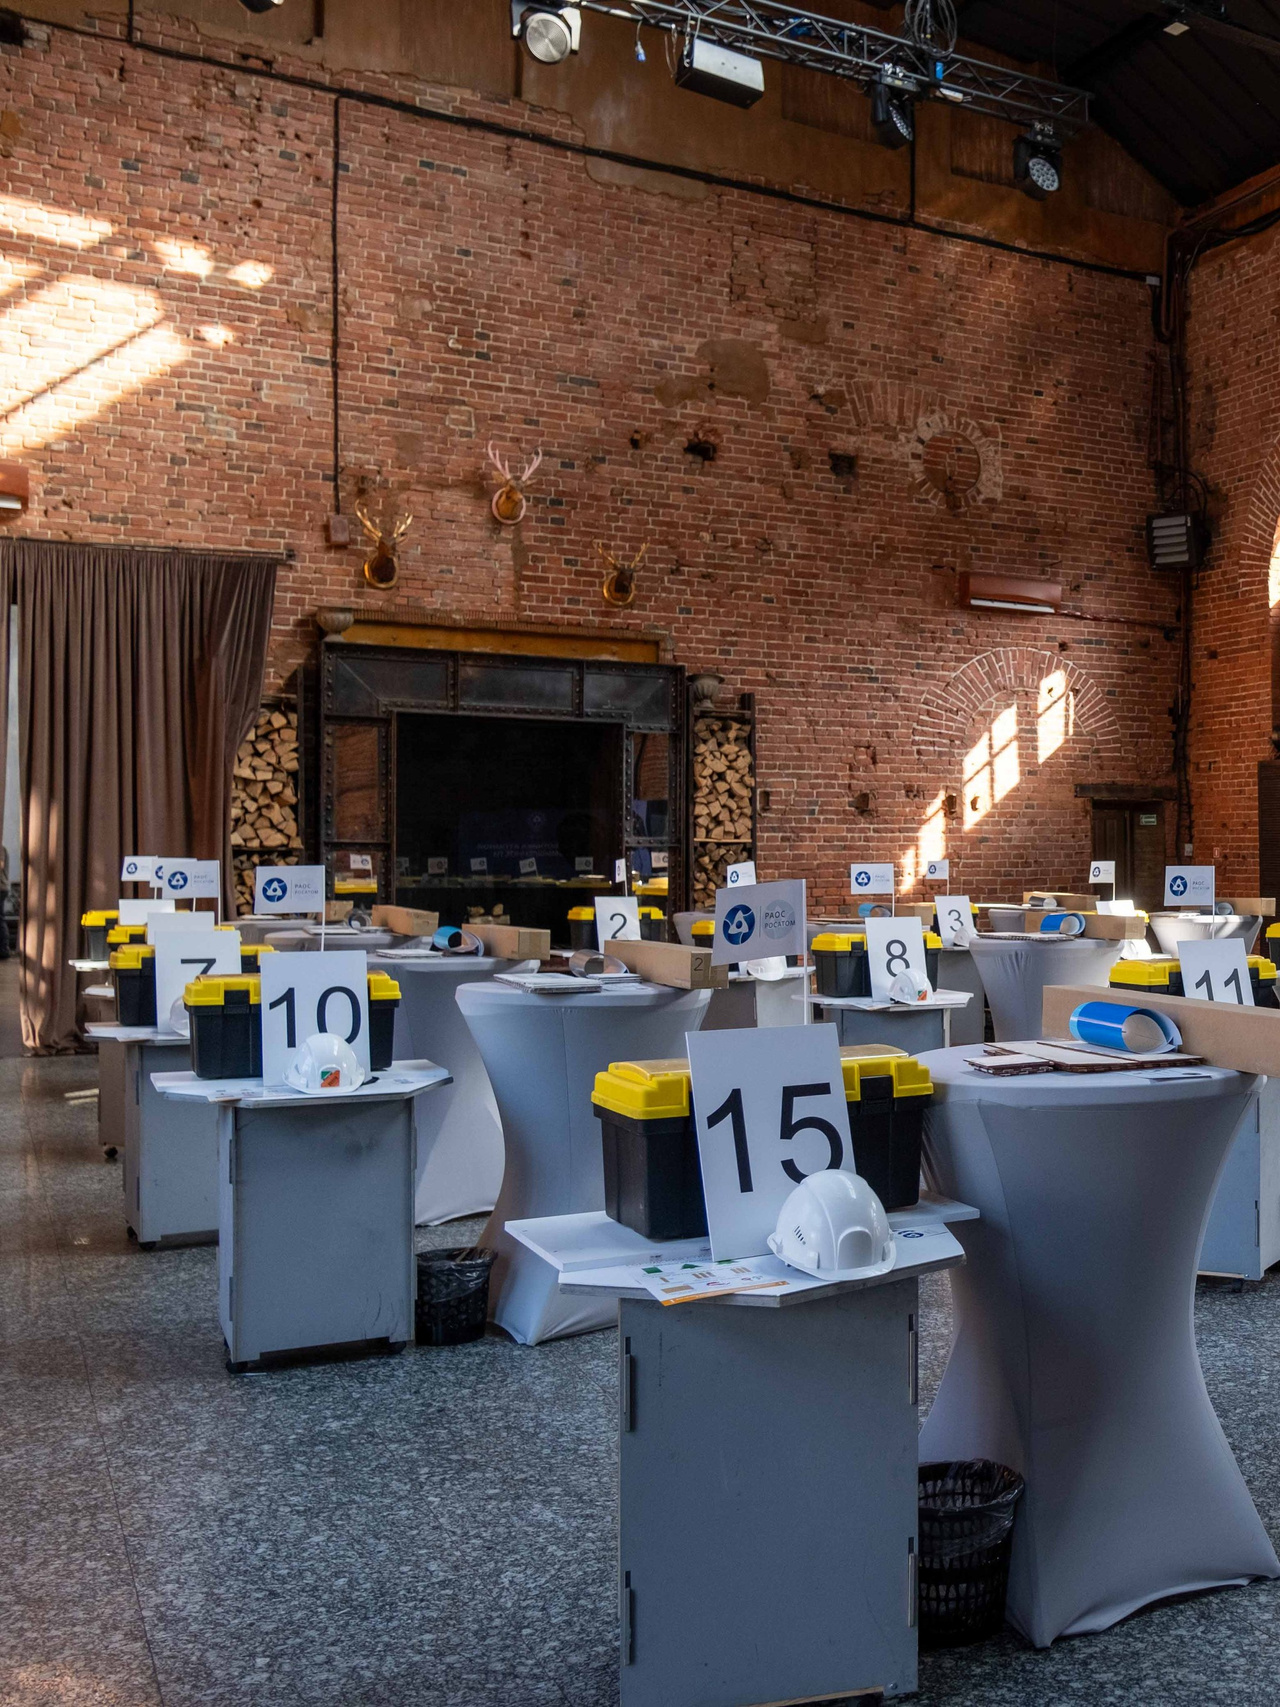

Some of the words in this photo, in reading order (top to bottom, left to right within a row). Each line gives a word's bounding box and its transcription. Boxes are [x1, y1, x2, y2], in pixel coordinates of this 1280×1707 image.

[609, 912, 628, 939] 2
[764, 910, 786, 920] РАОС
[764, 919, 796, 929] РОСАТОМ
[947, 908, 965, 932] 3
[693, 957, 704, 971] 2
[886, 939, 910, 977] 8
[1195, 968, 1244, 1005] 11
[268, 985, 361, 1049] 10
[706, 1081, 843, 1193] 15
